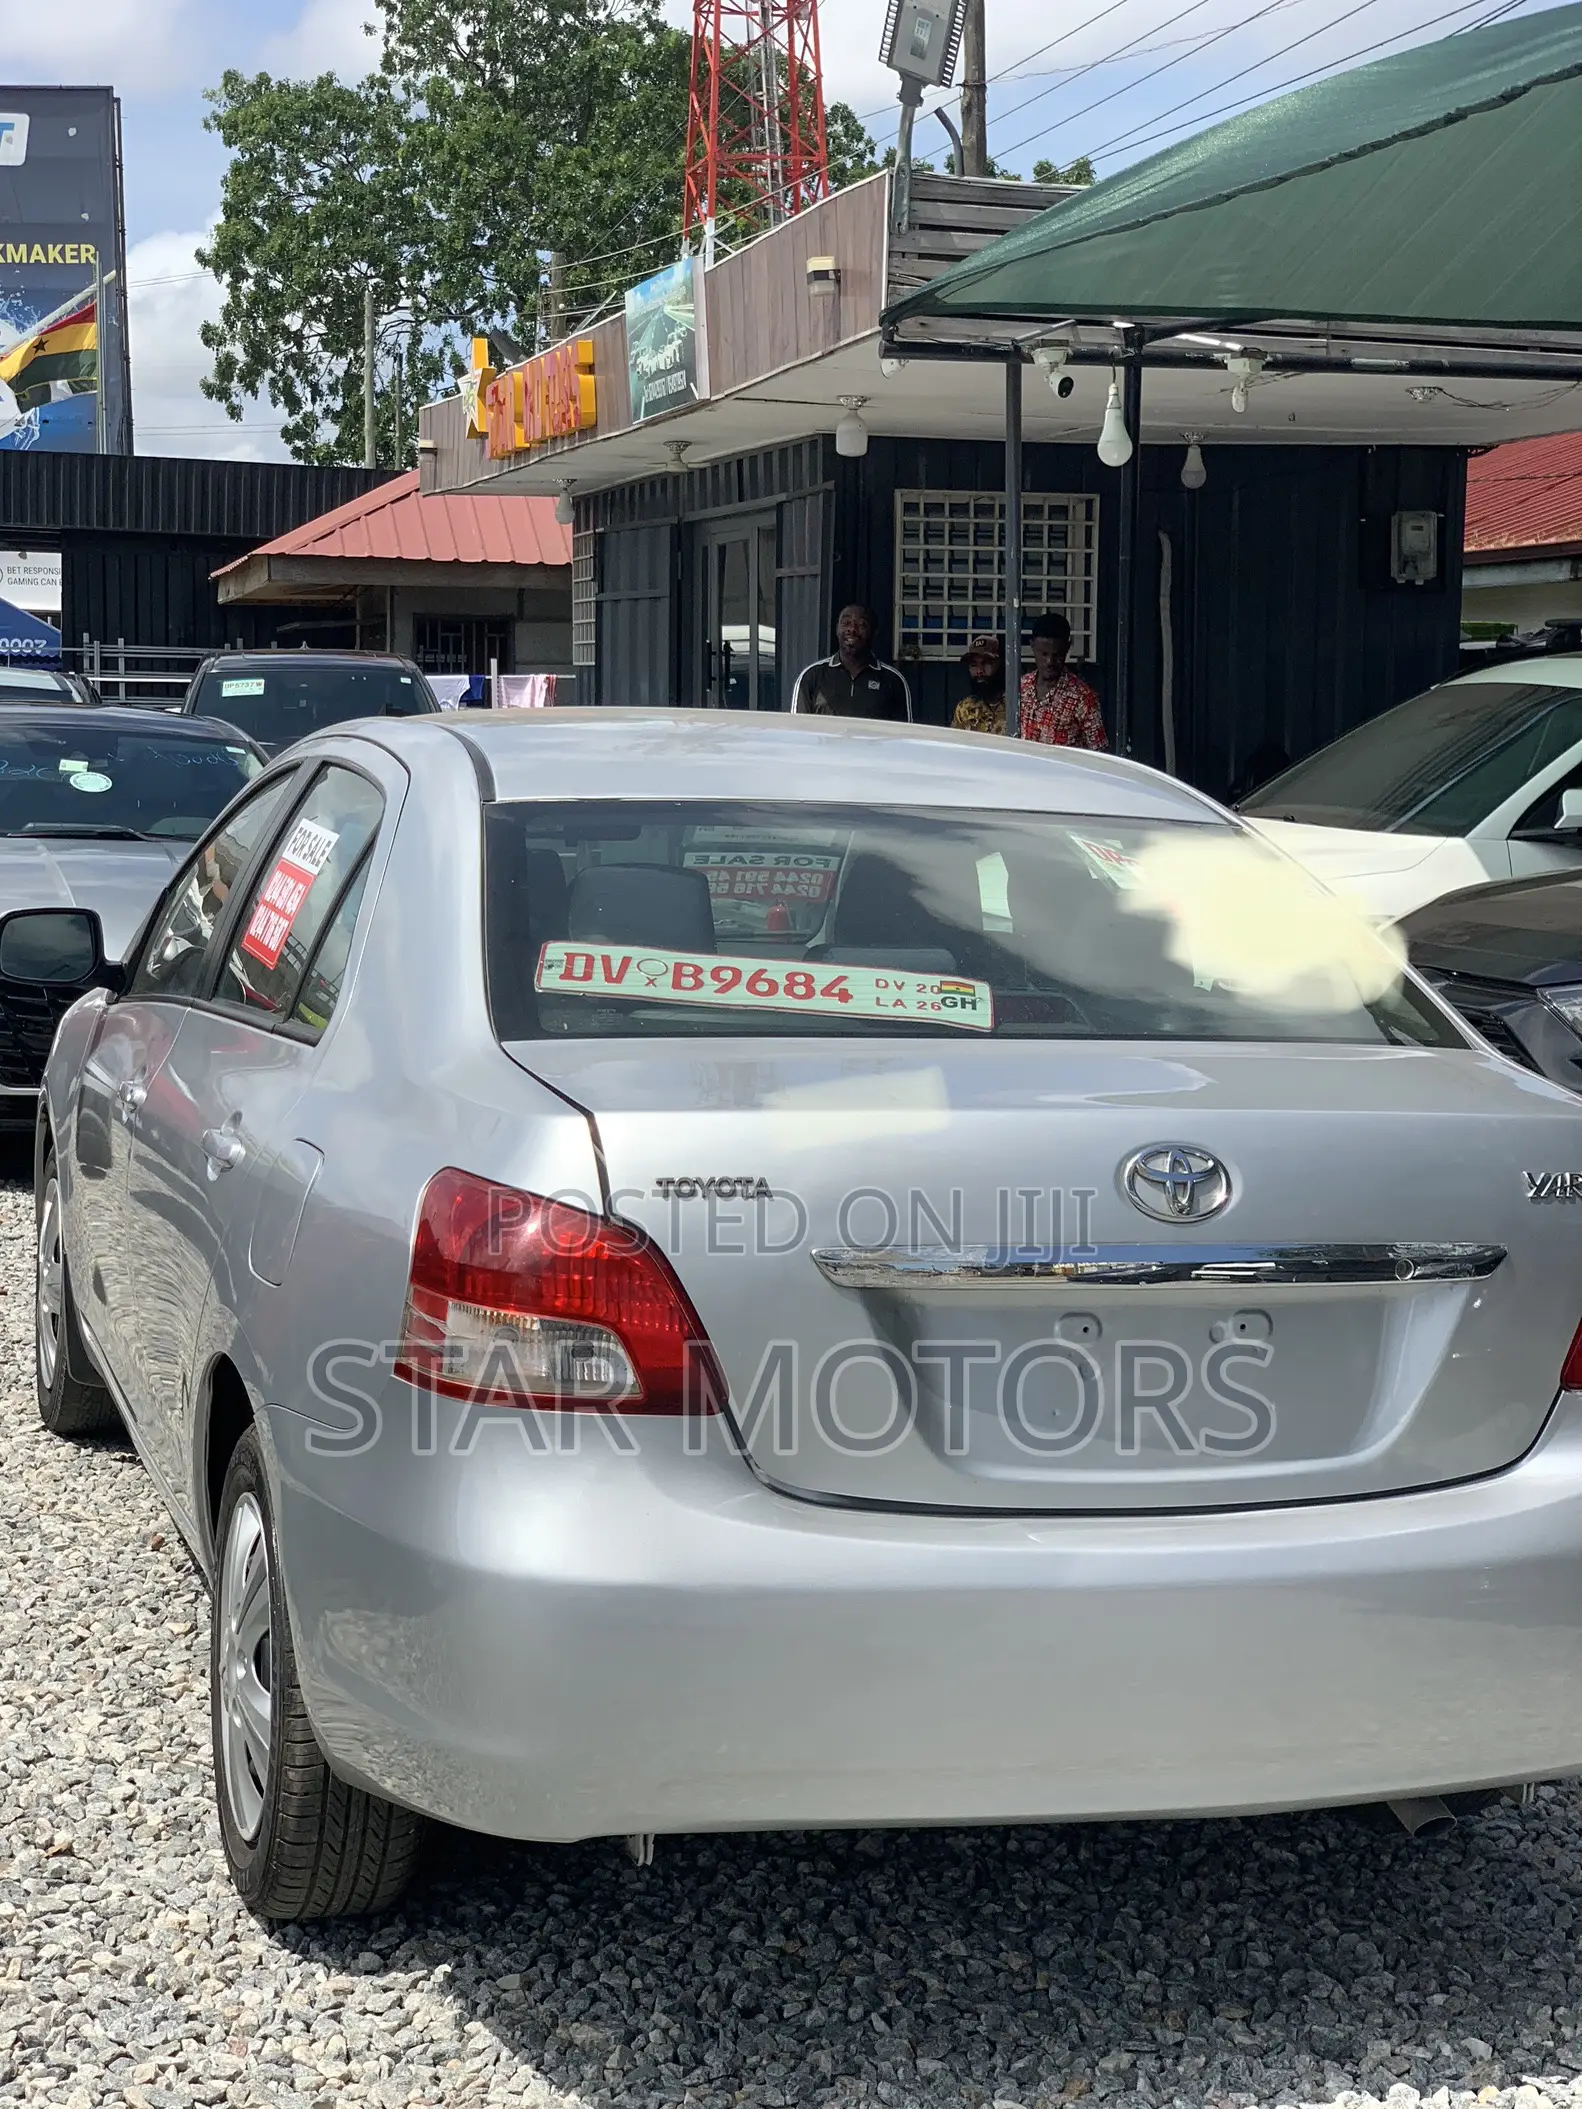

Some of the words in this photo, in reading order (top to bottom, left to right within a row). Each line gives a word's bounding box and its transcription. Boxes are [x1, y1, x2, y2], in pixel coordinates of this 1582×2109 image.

[7, 566, 21, 575] BET
[7, 577, 39, 586] GAMING
[40, 578, 57, 586] CAN
[303, 834, 333, 868] SALE
[558, 951, 633, 985] DV
[671, 961, 854, 1004] B9684
[875, 978, 905, 992] DV
[916, 983, 942, 995] 20
[875, 996, 907, 1010] LA
[916, 1000, 942, 1012] 26
[940, 996, 977, 1011] GH
[656, 1176, 774, 1202] TOYOTA
